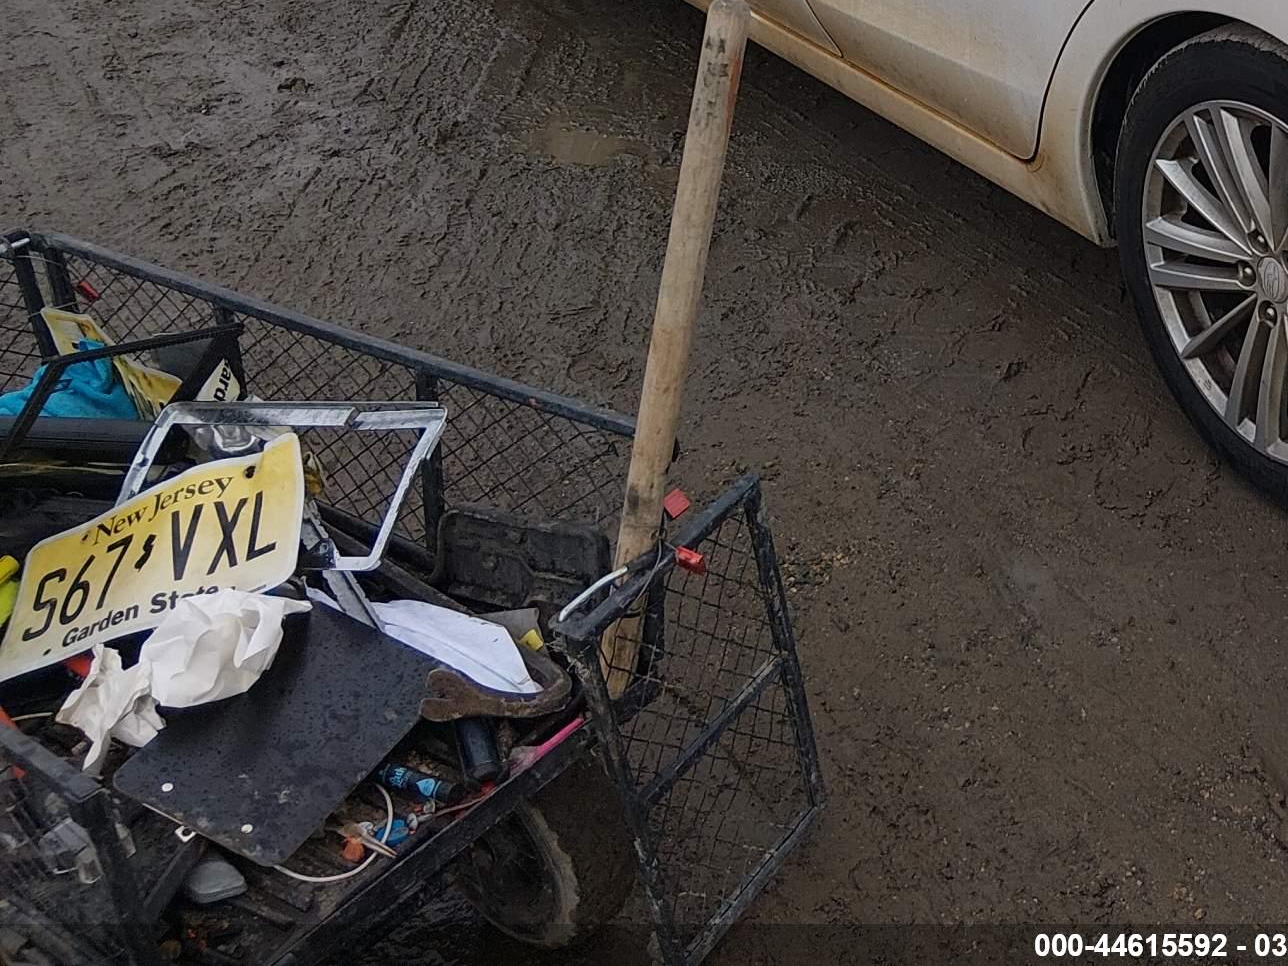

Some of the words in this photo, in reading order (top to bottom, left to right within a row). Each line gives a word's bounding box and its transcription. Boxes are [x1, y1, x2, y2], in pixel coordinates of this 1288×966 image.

[92, 506, 146, 546] New
[148, 475, 234, 522] Jersey
[62, 603, 139, 647] Garden
